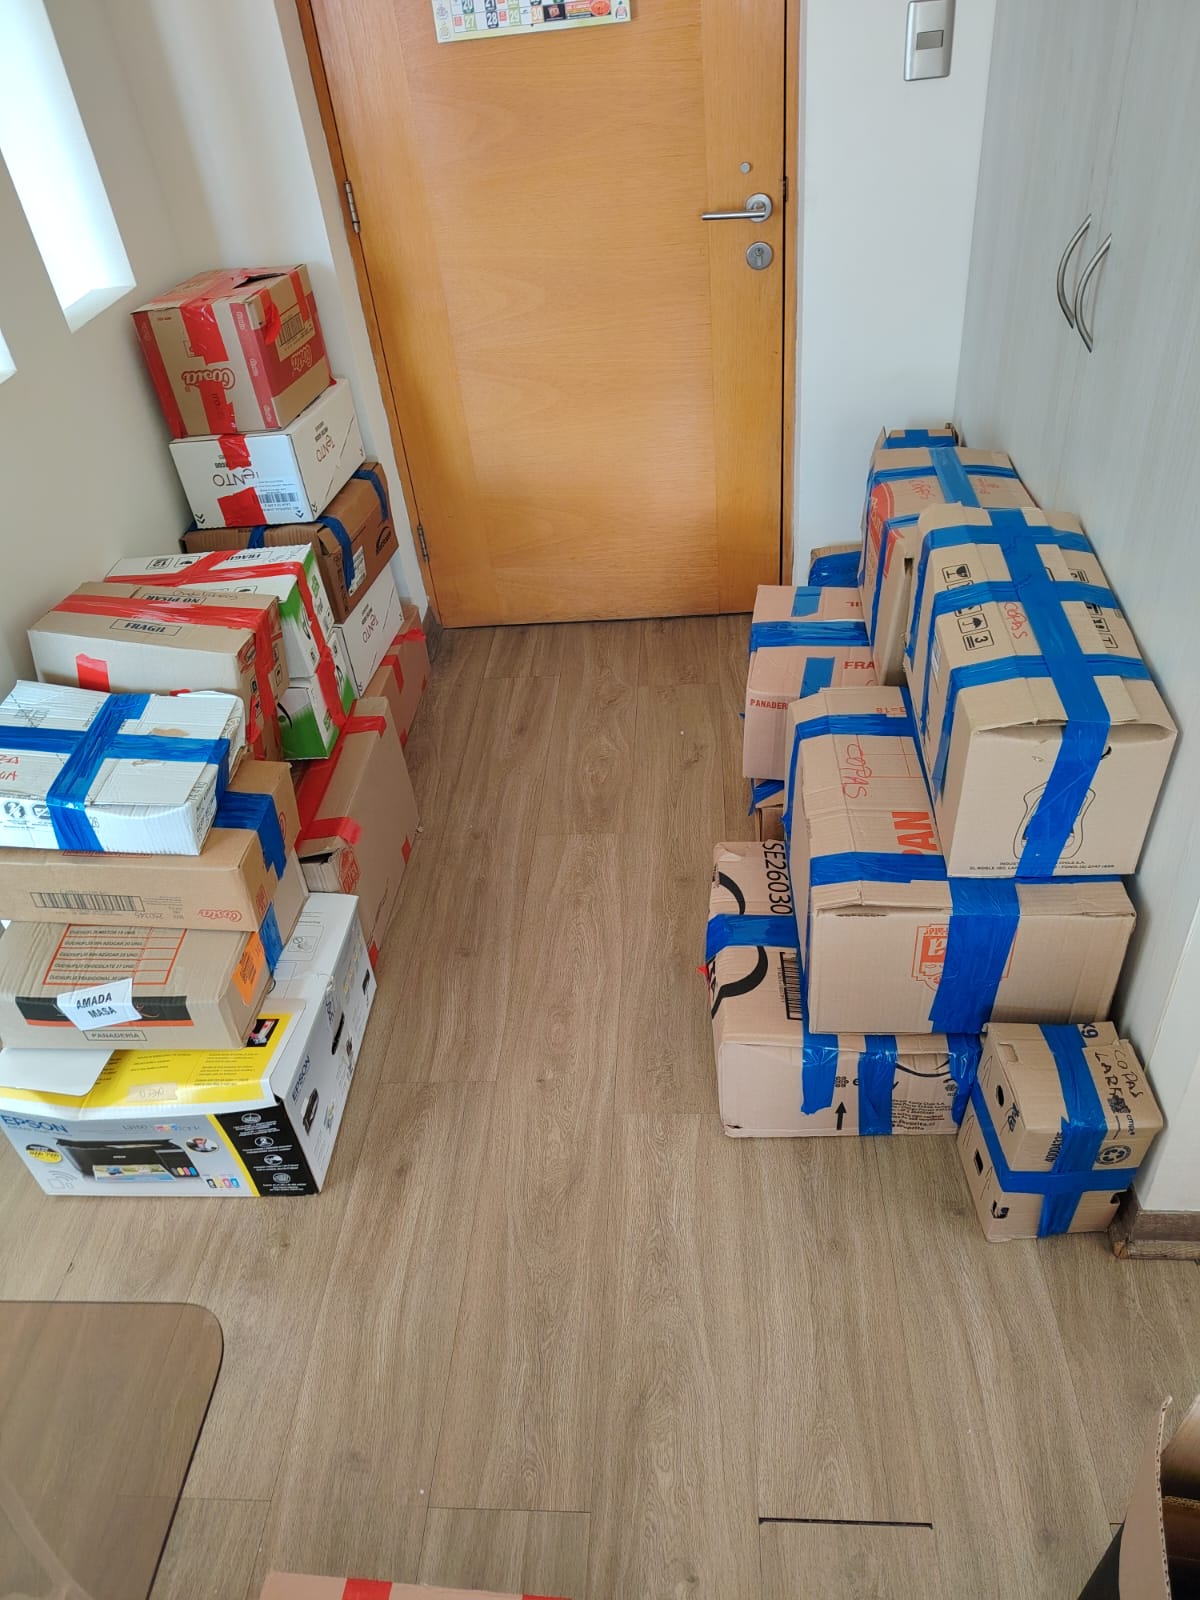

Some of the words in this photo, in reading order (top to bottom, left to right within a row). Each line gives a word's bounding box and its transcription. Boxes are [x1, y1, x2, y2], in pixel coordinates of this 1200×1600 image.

[124, 622, 166, 633] FRAGIL
[750, 698, 788, 711] PANADER
[762, 842, 793, 915] SE26030
[75, 991, 113, 1010] AMADA
[88, 1005, 117, 1019] MASA
[1113, 1049, 1144, 1098] COPAS
[0, 1114, 68, 1133] EPSON
